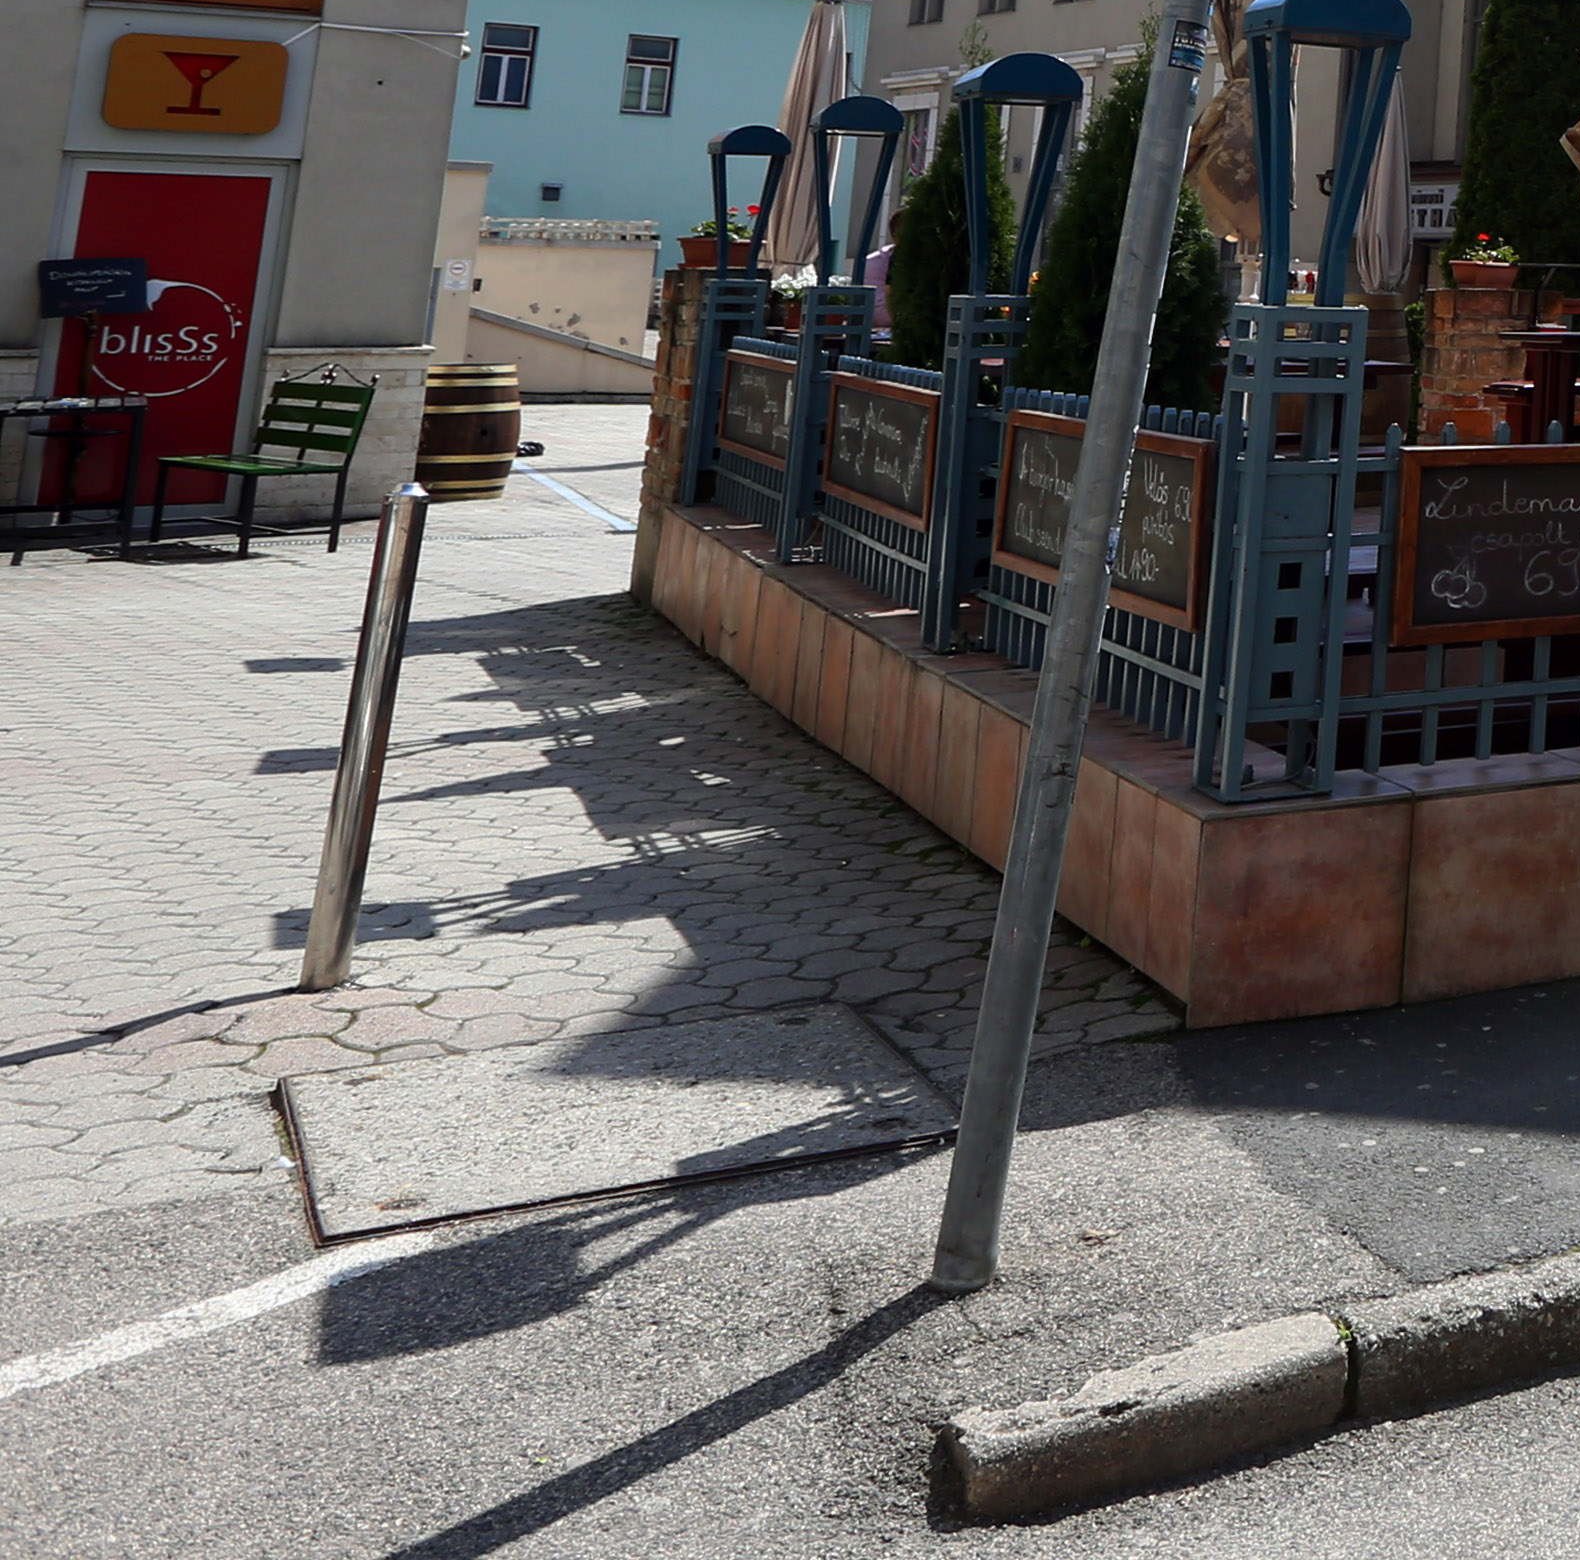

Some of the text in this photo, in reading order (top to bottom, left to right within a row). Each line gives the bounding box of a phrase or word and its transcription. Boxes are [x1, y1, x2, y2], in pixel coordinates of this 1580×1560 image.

[99, 325, 219, 354] blisSs
[147, 354, 214, 362] THE PLACE
